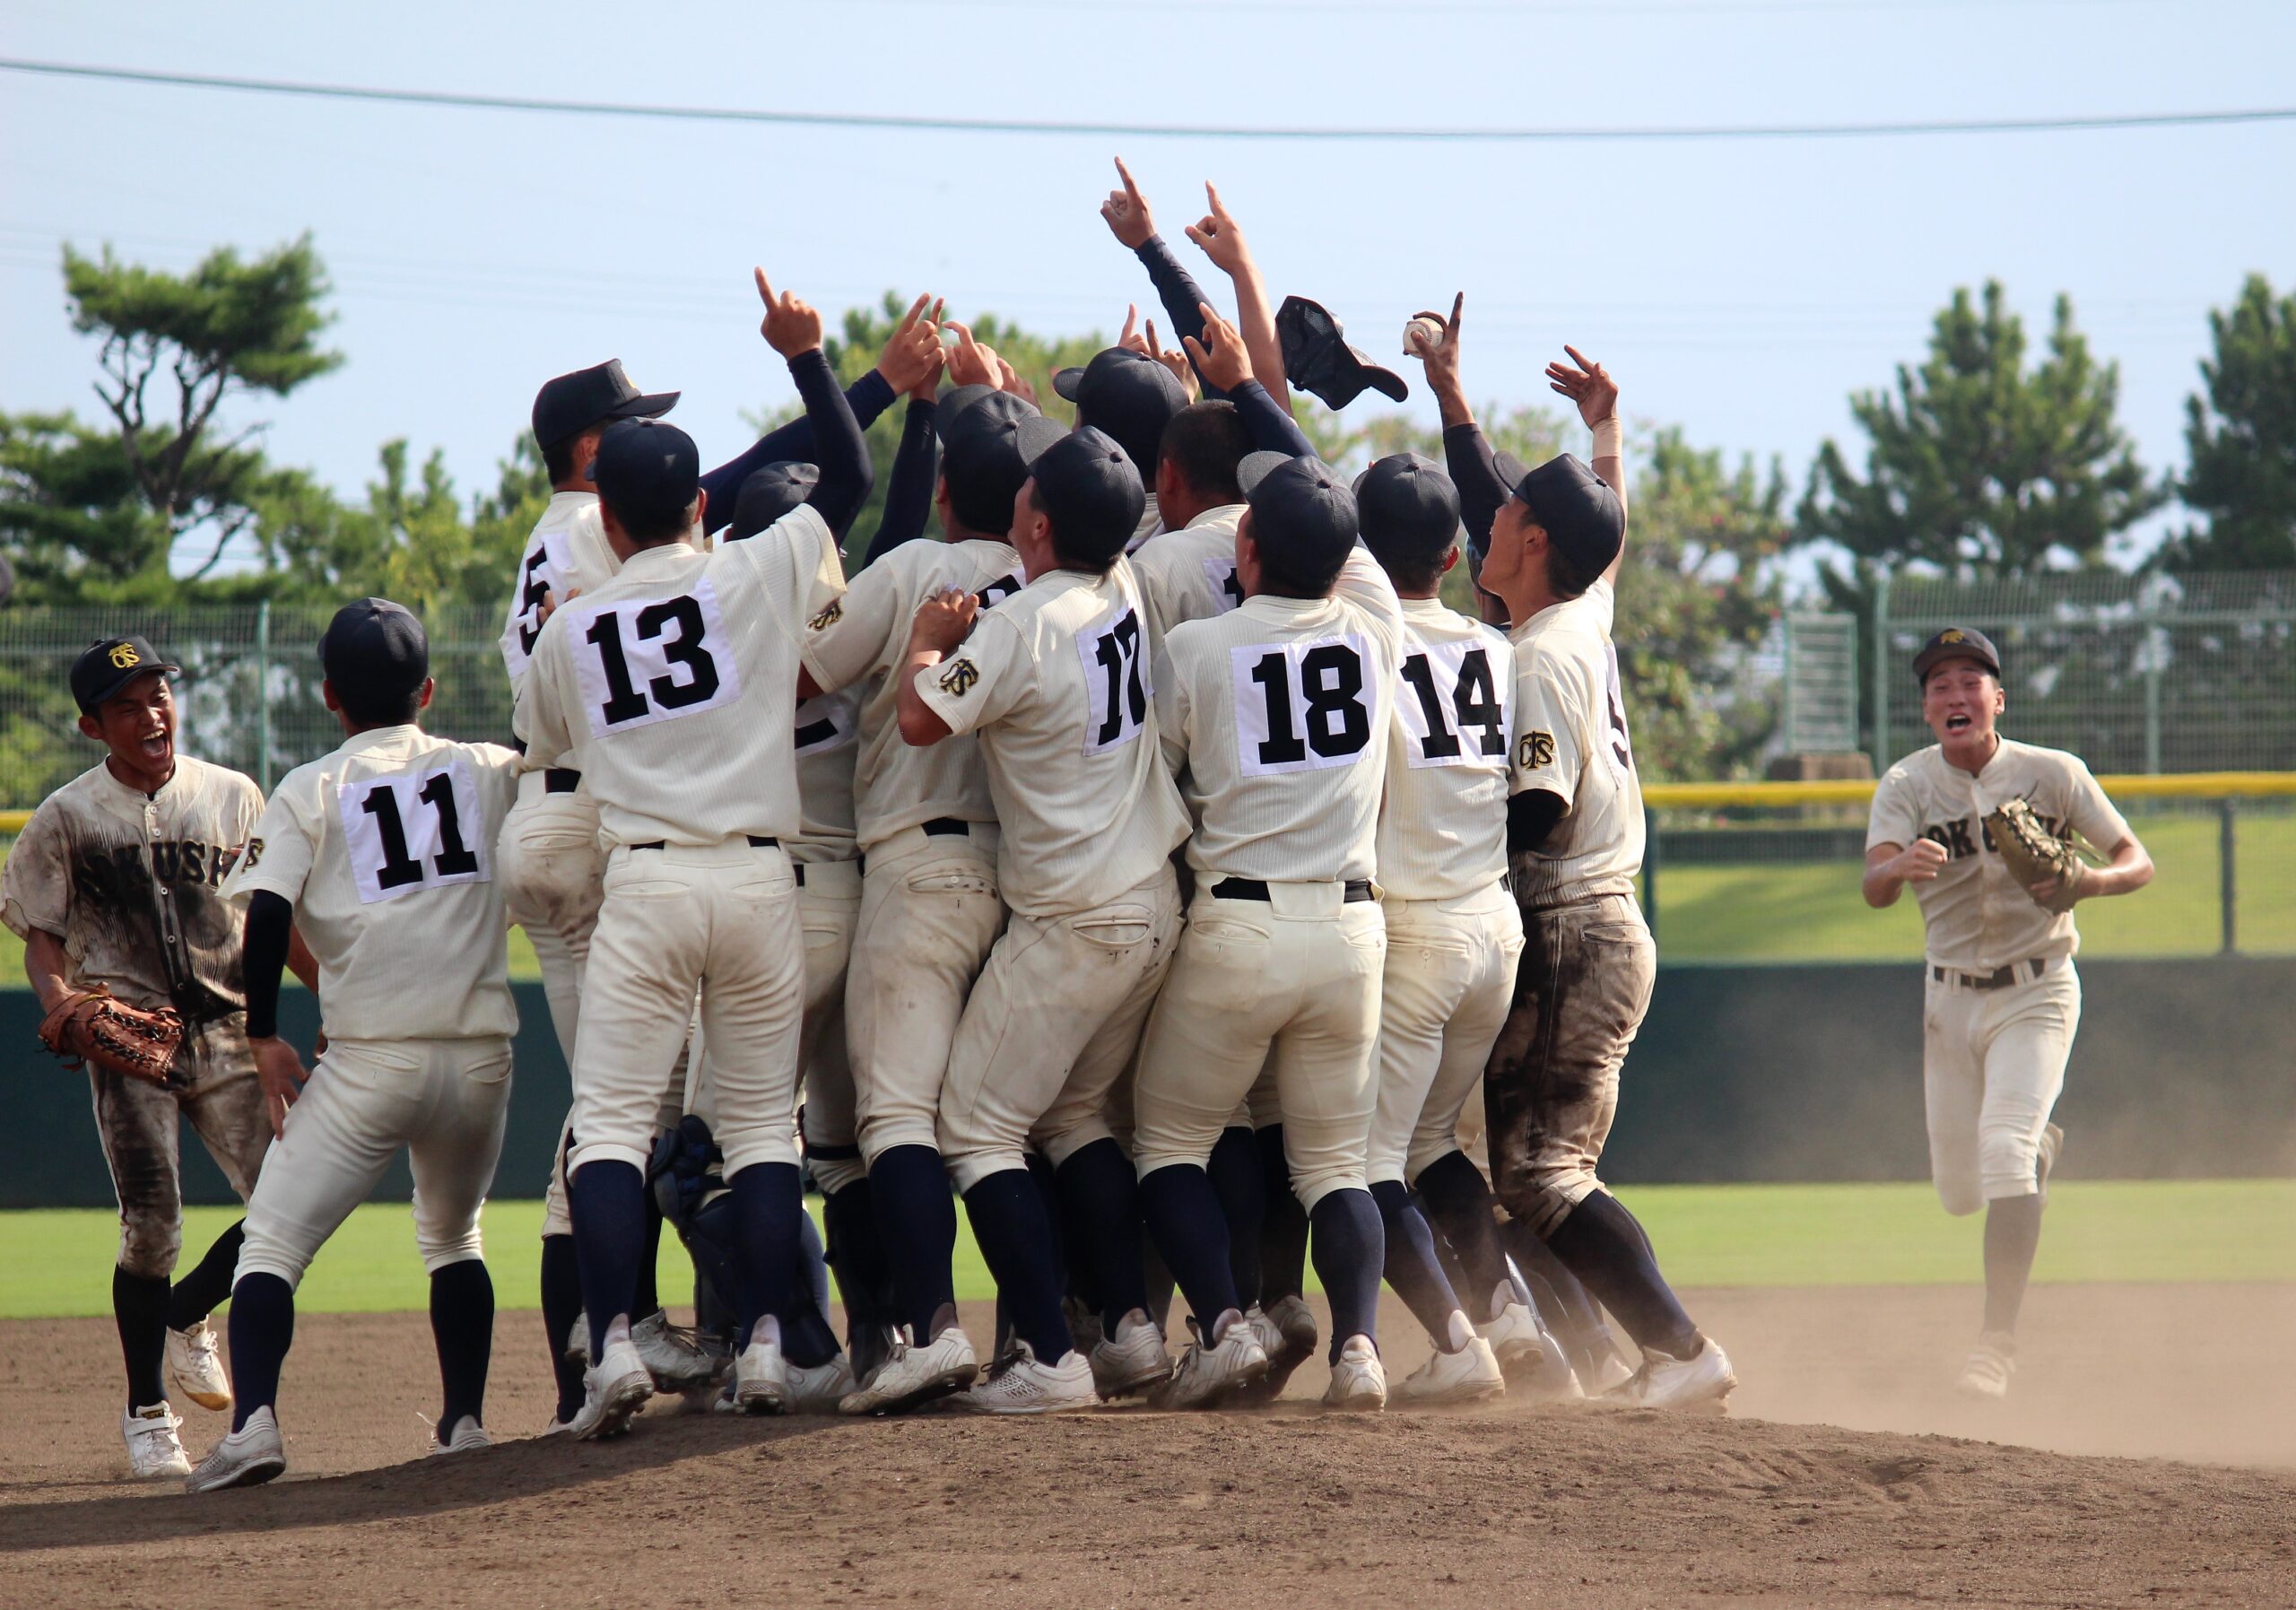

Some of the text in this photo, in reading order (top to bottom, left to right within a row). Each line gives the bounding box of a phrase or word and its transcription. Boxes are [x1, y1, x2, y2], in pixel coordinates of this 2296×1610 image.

[586, 595, 720, 726] 13
[1095, 607, 1146, 746] 17
[1251, 644, 1370, 765] 18
[1399, 648, 1507, 759] 14
[361, 772, 477, 890] 11
